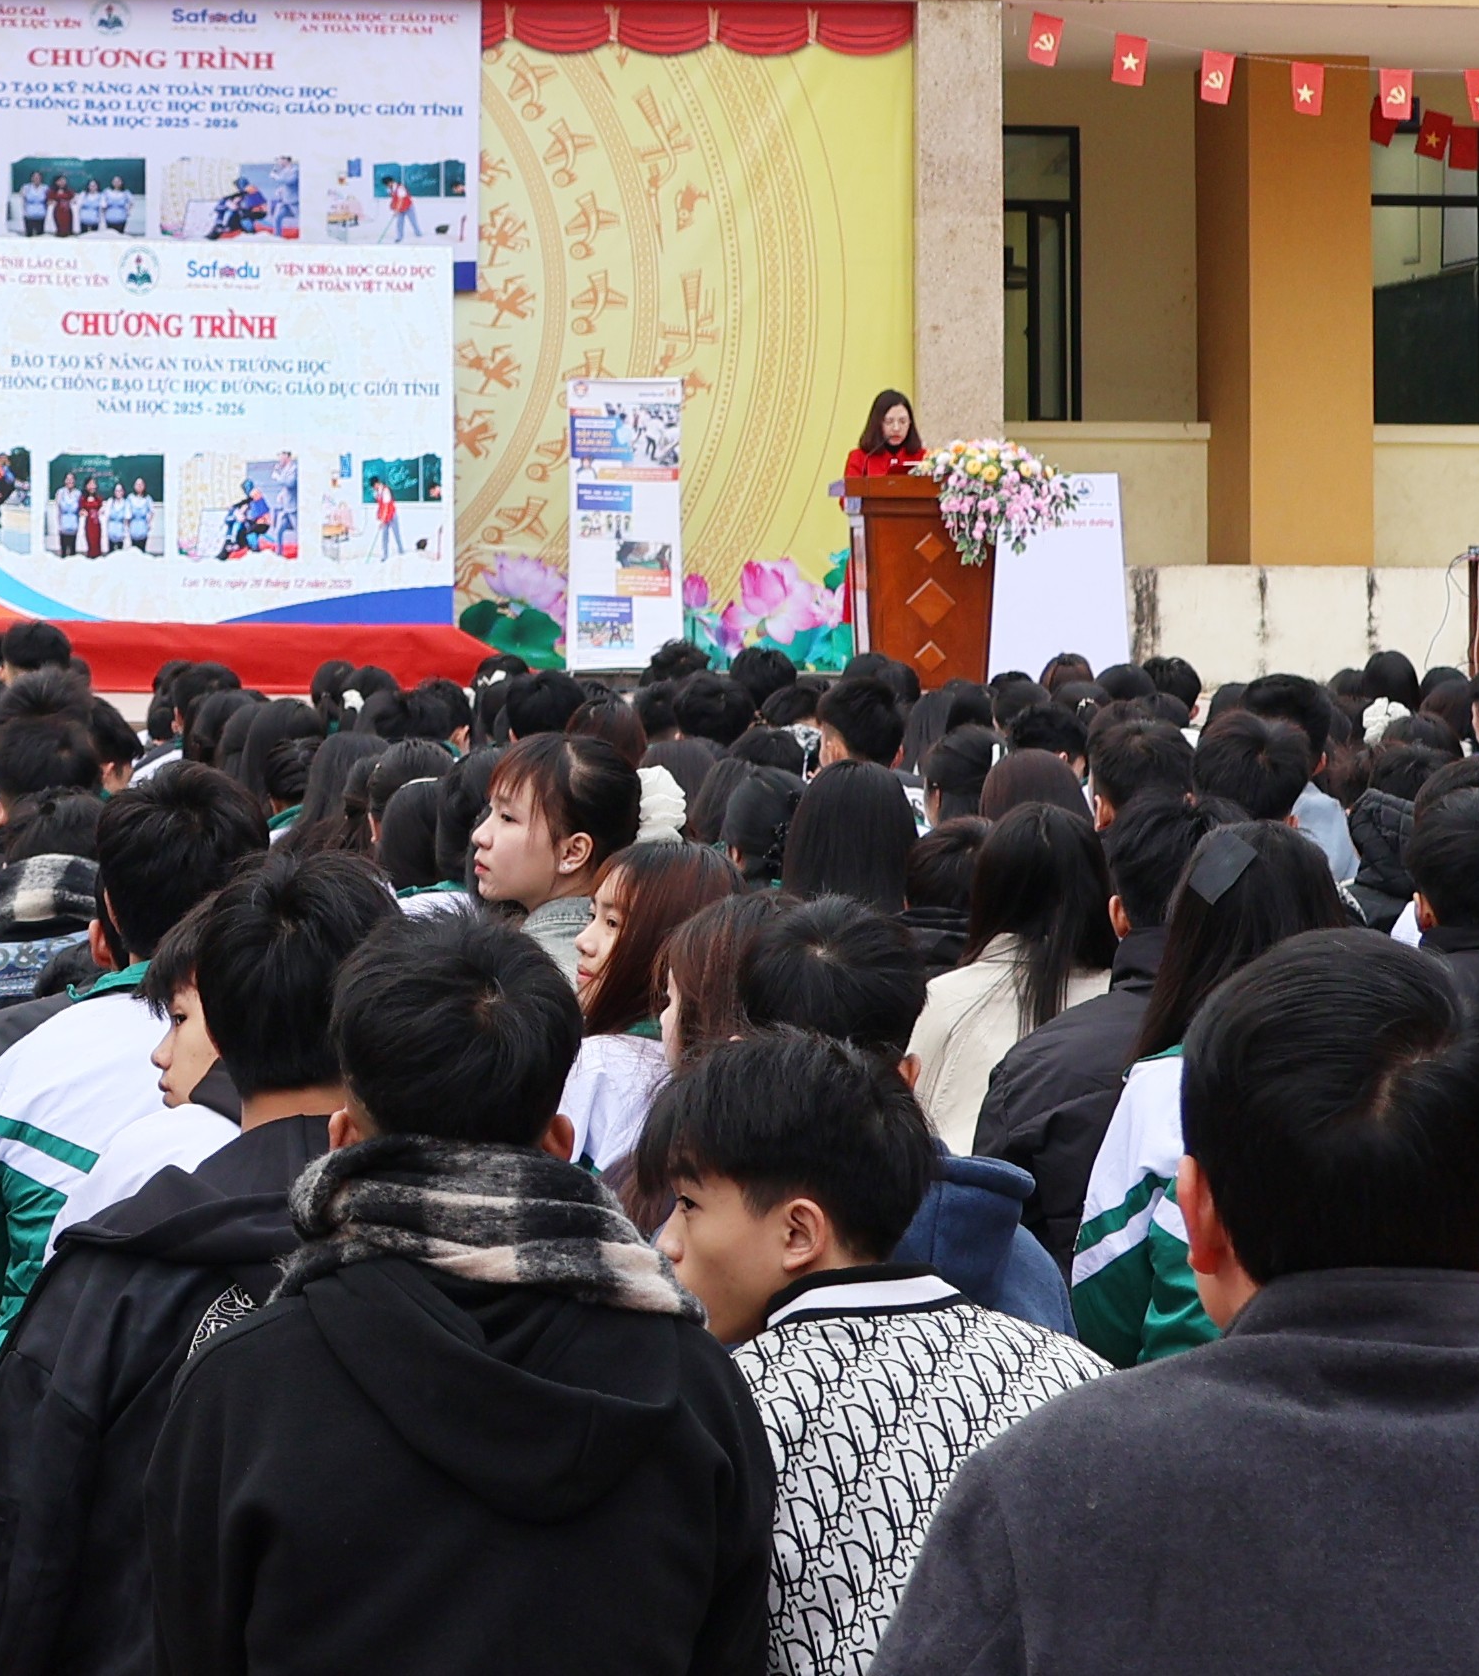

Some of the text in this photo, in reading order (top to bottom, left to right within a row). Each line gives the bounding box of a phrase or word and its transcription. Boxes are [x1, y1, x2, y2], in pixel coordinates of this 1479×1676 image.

[21, 5, 45, 16] CAI
[311, 11, 351, 22] KHOA
[356, 12, 385, 23] HỌC
[390, 10, 426, 23] GIÁO
[430, 14, 459, 26] DỤC
[54, 15, 82, 29] YÊN
[299, 24, 319, 33] AN
[323, 22, 360, 34] TOÀN
[401, 25, 434, 35] NAM
[27, 45, 275, 70] CHƯƠNG TRÌNH
[12, 81, 48, 97] TẠO
[53, 79, 77, 93] KỸ
[82, 80, 131, 94] NĂNG
[136, 84, 160, 94] AN
[166, 81, 214, 96] TOÀN
[218, 82, 294, 97] TRƯỜNG
[298, 86, 338, 100] HỌC
[15, 92, 80, 110] CHỐNG
[85, 98, 121, 114] BẠO
[126, 98, 163, 115] LỰC
[168, 100, 206, 115] HỌC
[285, 98, 330, 115] GIÁO
[335, 103, 372, 118] DỤC
[376, 100, 416, 116] GIỚI
[419, 100, 464, 117] TÍNH
[67, 111, 238, 130] NĂM HỌC 2025 2026
[55, 258, 78, 270] CAI
[346, 263, 372, 279] HỌC
[375, 262, 407, 277] GIÁO
[410, 265, 436, 280] DỤC
[84, 271, 110, 287] YÊN
[296, 279, 315, 291] AN
[318, 277, 351, 292] TOÀN
[386, 281, 414, 293] NAM
[62, 307, 277, 339] CHƯƠNG TRÌNH
[10, 350, 44, 369] ĐÀO
[47, 355, 80, 373] TẠO
[109, 353, 153, 370] NĂNG
[156, 357, 177, 370] AN
[182, 354, 224, 372] TOÀN
[228, 355, 294, 373] TRƯỜNG
[297, 359, 331, 377] HỌC
[51, 371, 109, 391] CHỐNG
[111, 377, 144, 395] BẠO
[147, 377, 180, 396] LỰC
[183, 379, 218, 397] HỌC
[286, 377, 325, 396] GIÁO
[328, 382, 361, 399] DỤC
[364, 379, 398, 396] GIỚI
[402, 378, 440, 397] TÍNH
[97, 395, 246, 417] NĂM HỌC 2025 2026
